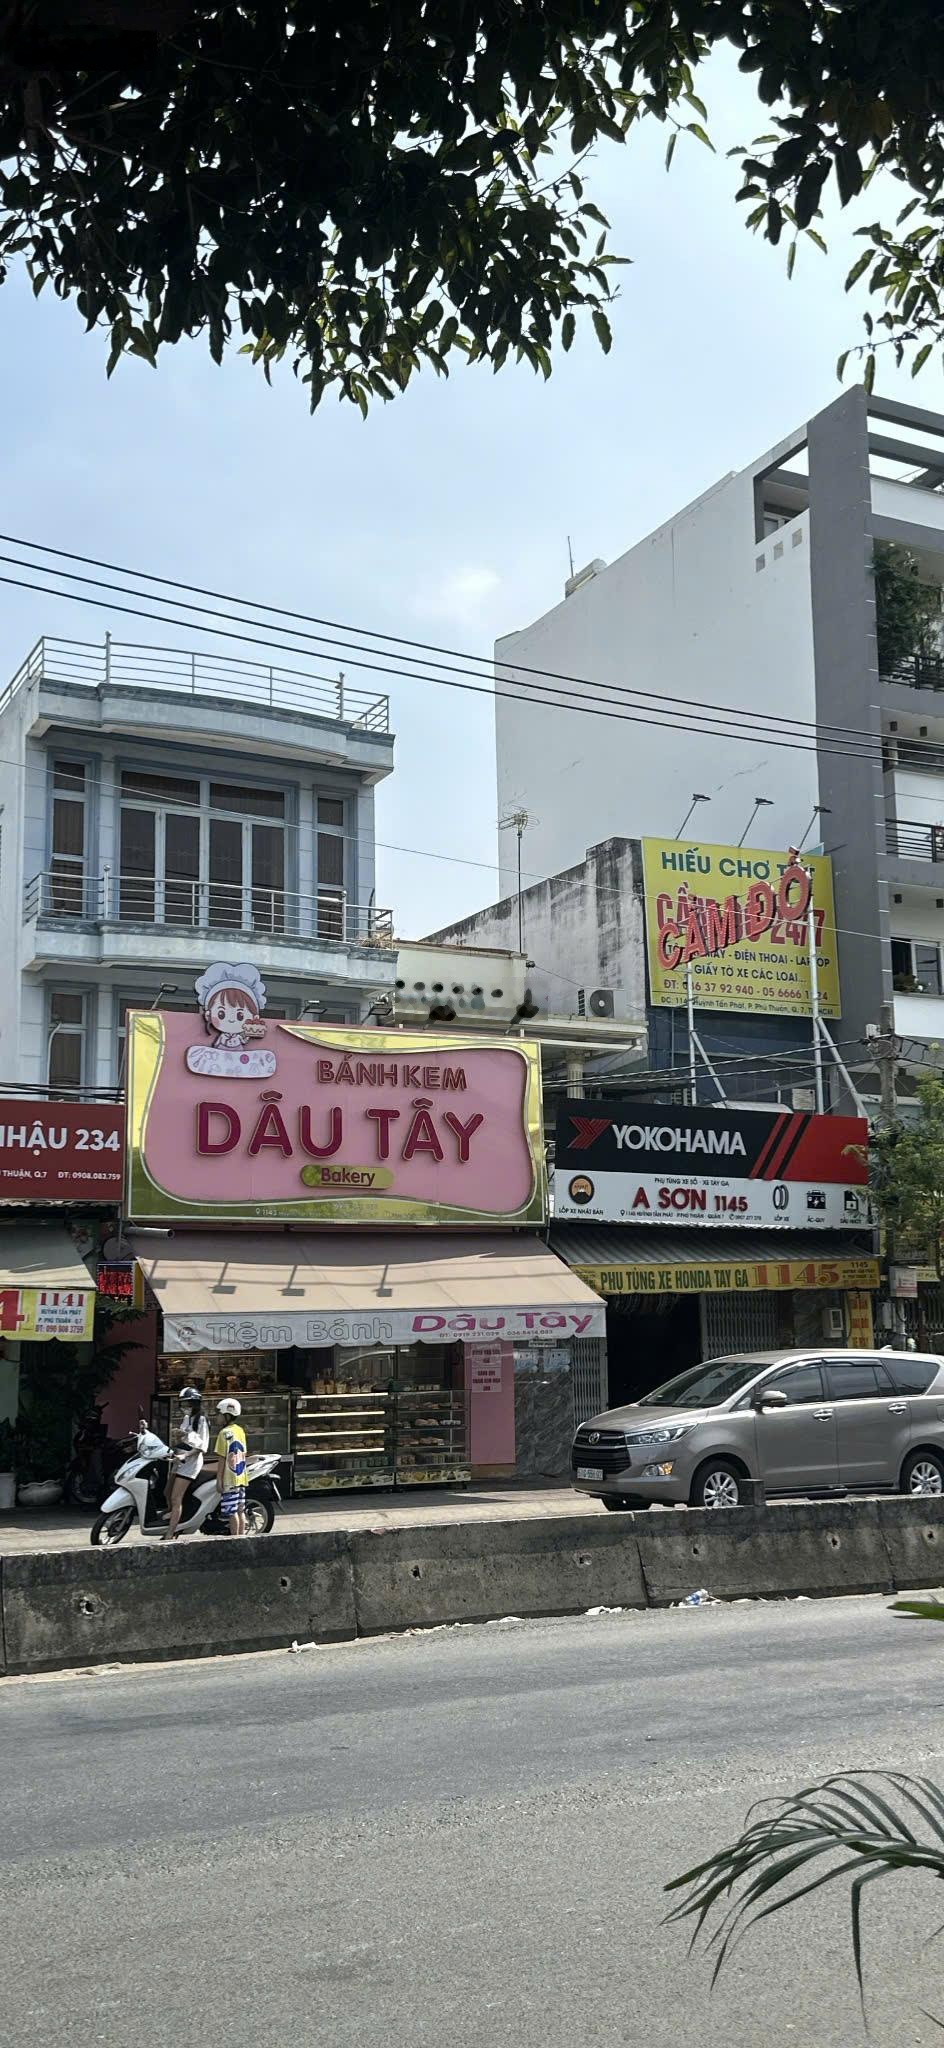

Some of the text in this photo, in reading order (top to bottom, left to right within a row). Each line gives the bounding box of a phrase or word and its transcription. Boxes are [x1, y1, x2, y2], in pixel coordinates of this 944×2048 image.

[661, 847, 711, 875] HIẾU
[734, 949, 756, 964] ĐIỆN
[759, 953, 788, 967] THOẠI
[694, 962, 719, 976] GIẤY
[737, 967, 749, 979] XE
[751, 967, 774, 981] CÁC
[663, 979, 680, 991] ĐT:
[705, 982, 717, 994] 37
[719, 984, 733, 995] 92
[736, 985, 754, 996] 940
[762, 987, 775, 998] 05
[777, 988, 802, 999] 6666
[317, 1054, 469, 1092] BÁNH KEM
[195, 1090, 485, 1163] DÂU TÂY
[75, 1128, 121, 1152] 234
[611, 1123, 748, 1157] YOKOHAMA
[34, 1171, 49, 1179] Q.7
[58, 1170, 71, 1179] ĐT:
[320, 1167, 376, 1187] Bakery
[632, 1186, 749, 1213] A SƠN 1145
[657, 1270, 673, 1290] XE
[675, 1269, 712, 1290] HONDA
[713, 1268, 732, 1289] TAY
[734, 1268, 750, 1288] GA
[751, 1263, 842, 1288] 1145
[39, 1292, 85, 1307] 1141
[206, 1311, 593, 1349] Tiệm Bánh Dâu Tây
